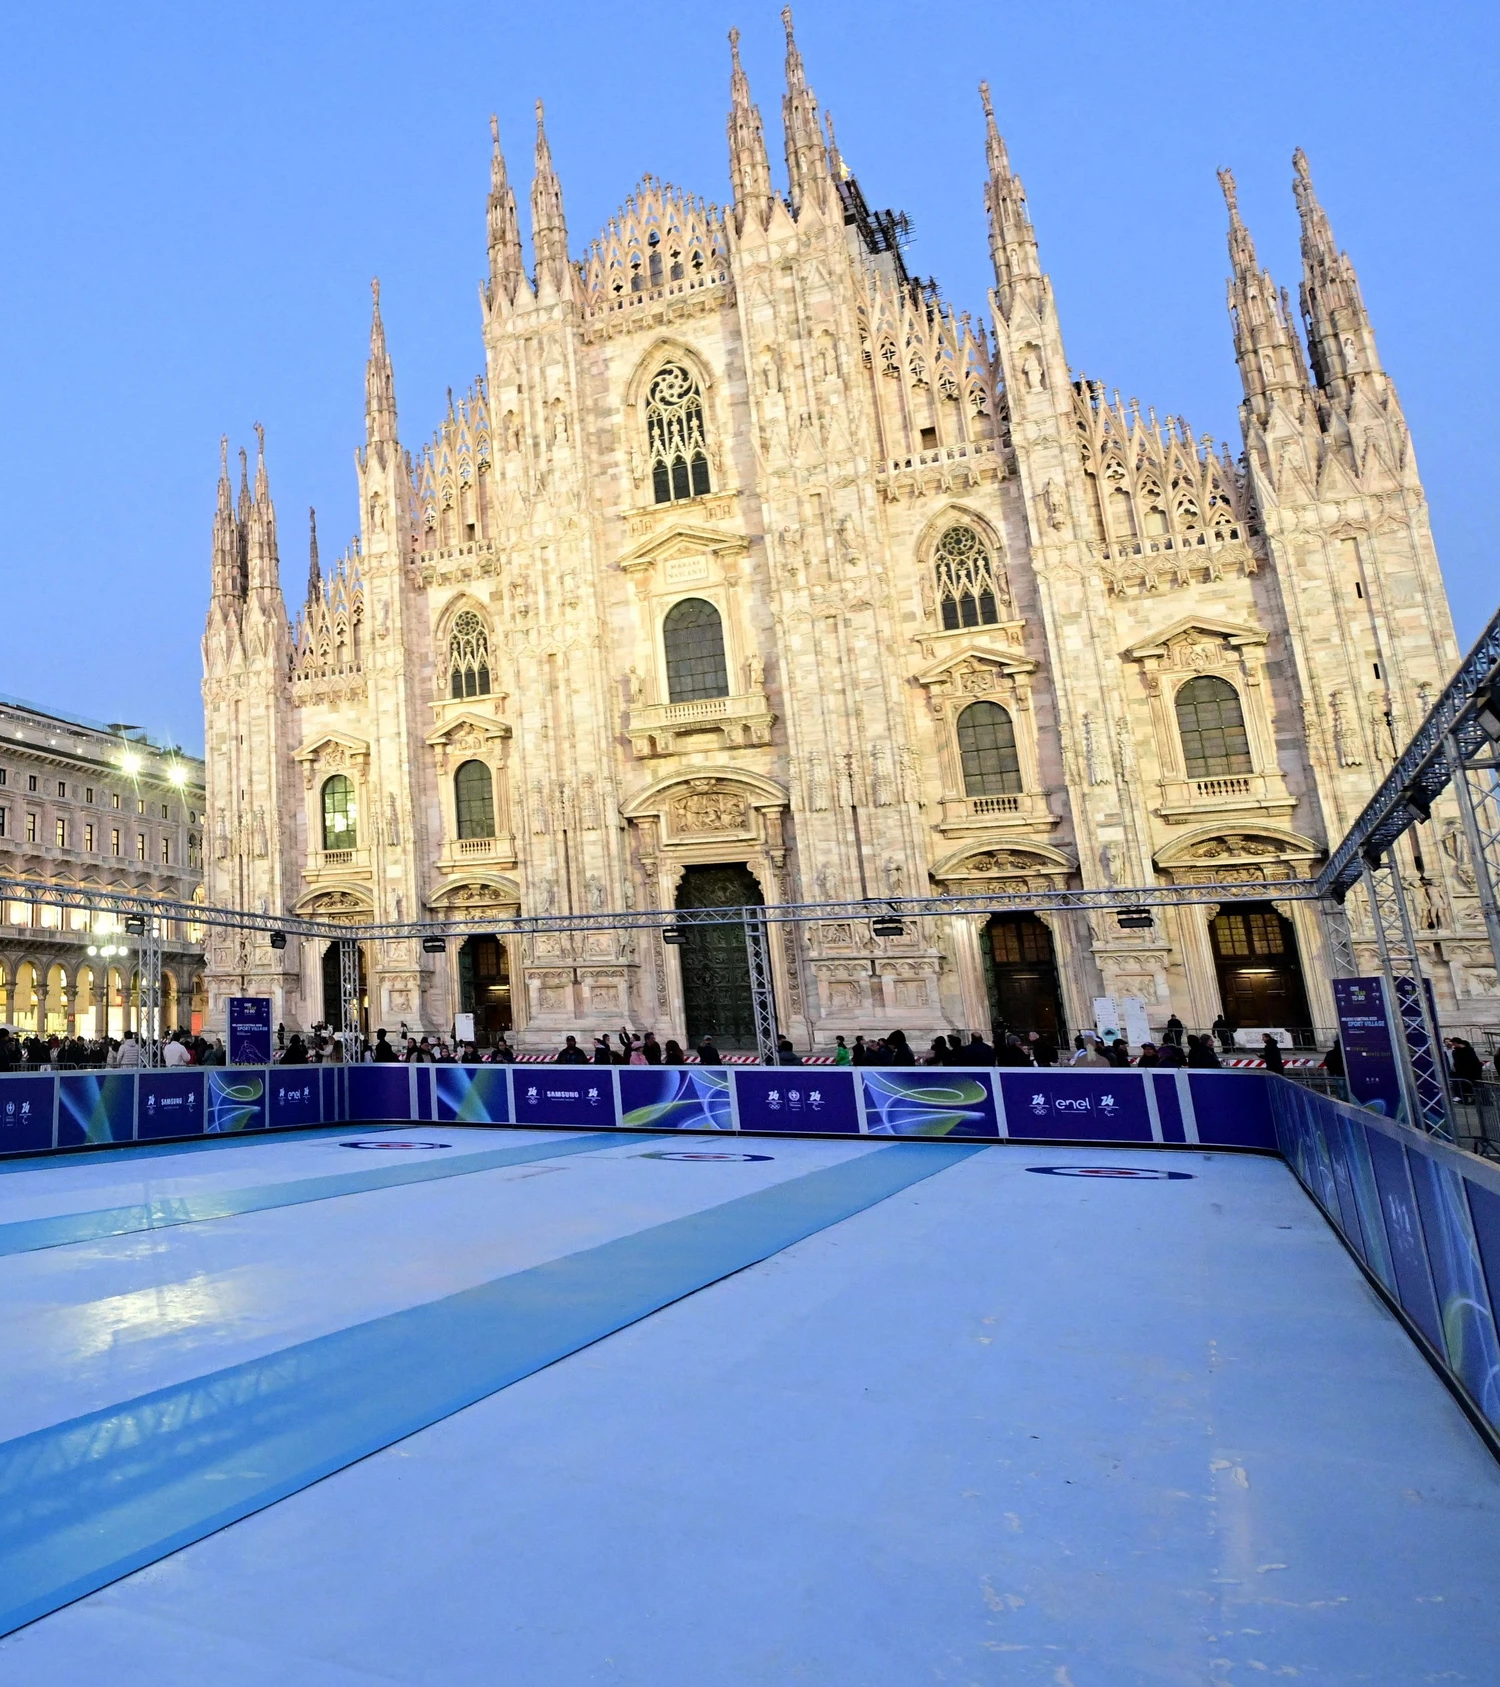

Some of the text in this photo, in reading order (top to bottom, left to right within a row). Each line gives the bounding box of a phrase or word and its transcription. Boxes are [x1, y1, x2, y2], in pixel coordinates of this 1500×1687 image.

[287, 1088, 301, 1100] enel
[546, 1090, 579, 1098] SAMSUNG
[161, 1097, 183, 1106] SAMSUNG
[1055, 1097, 1091, 1110] enel
